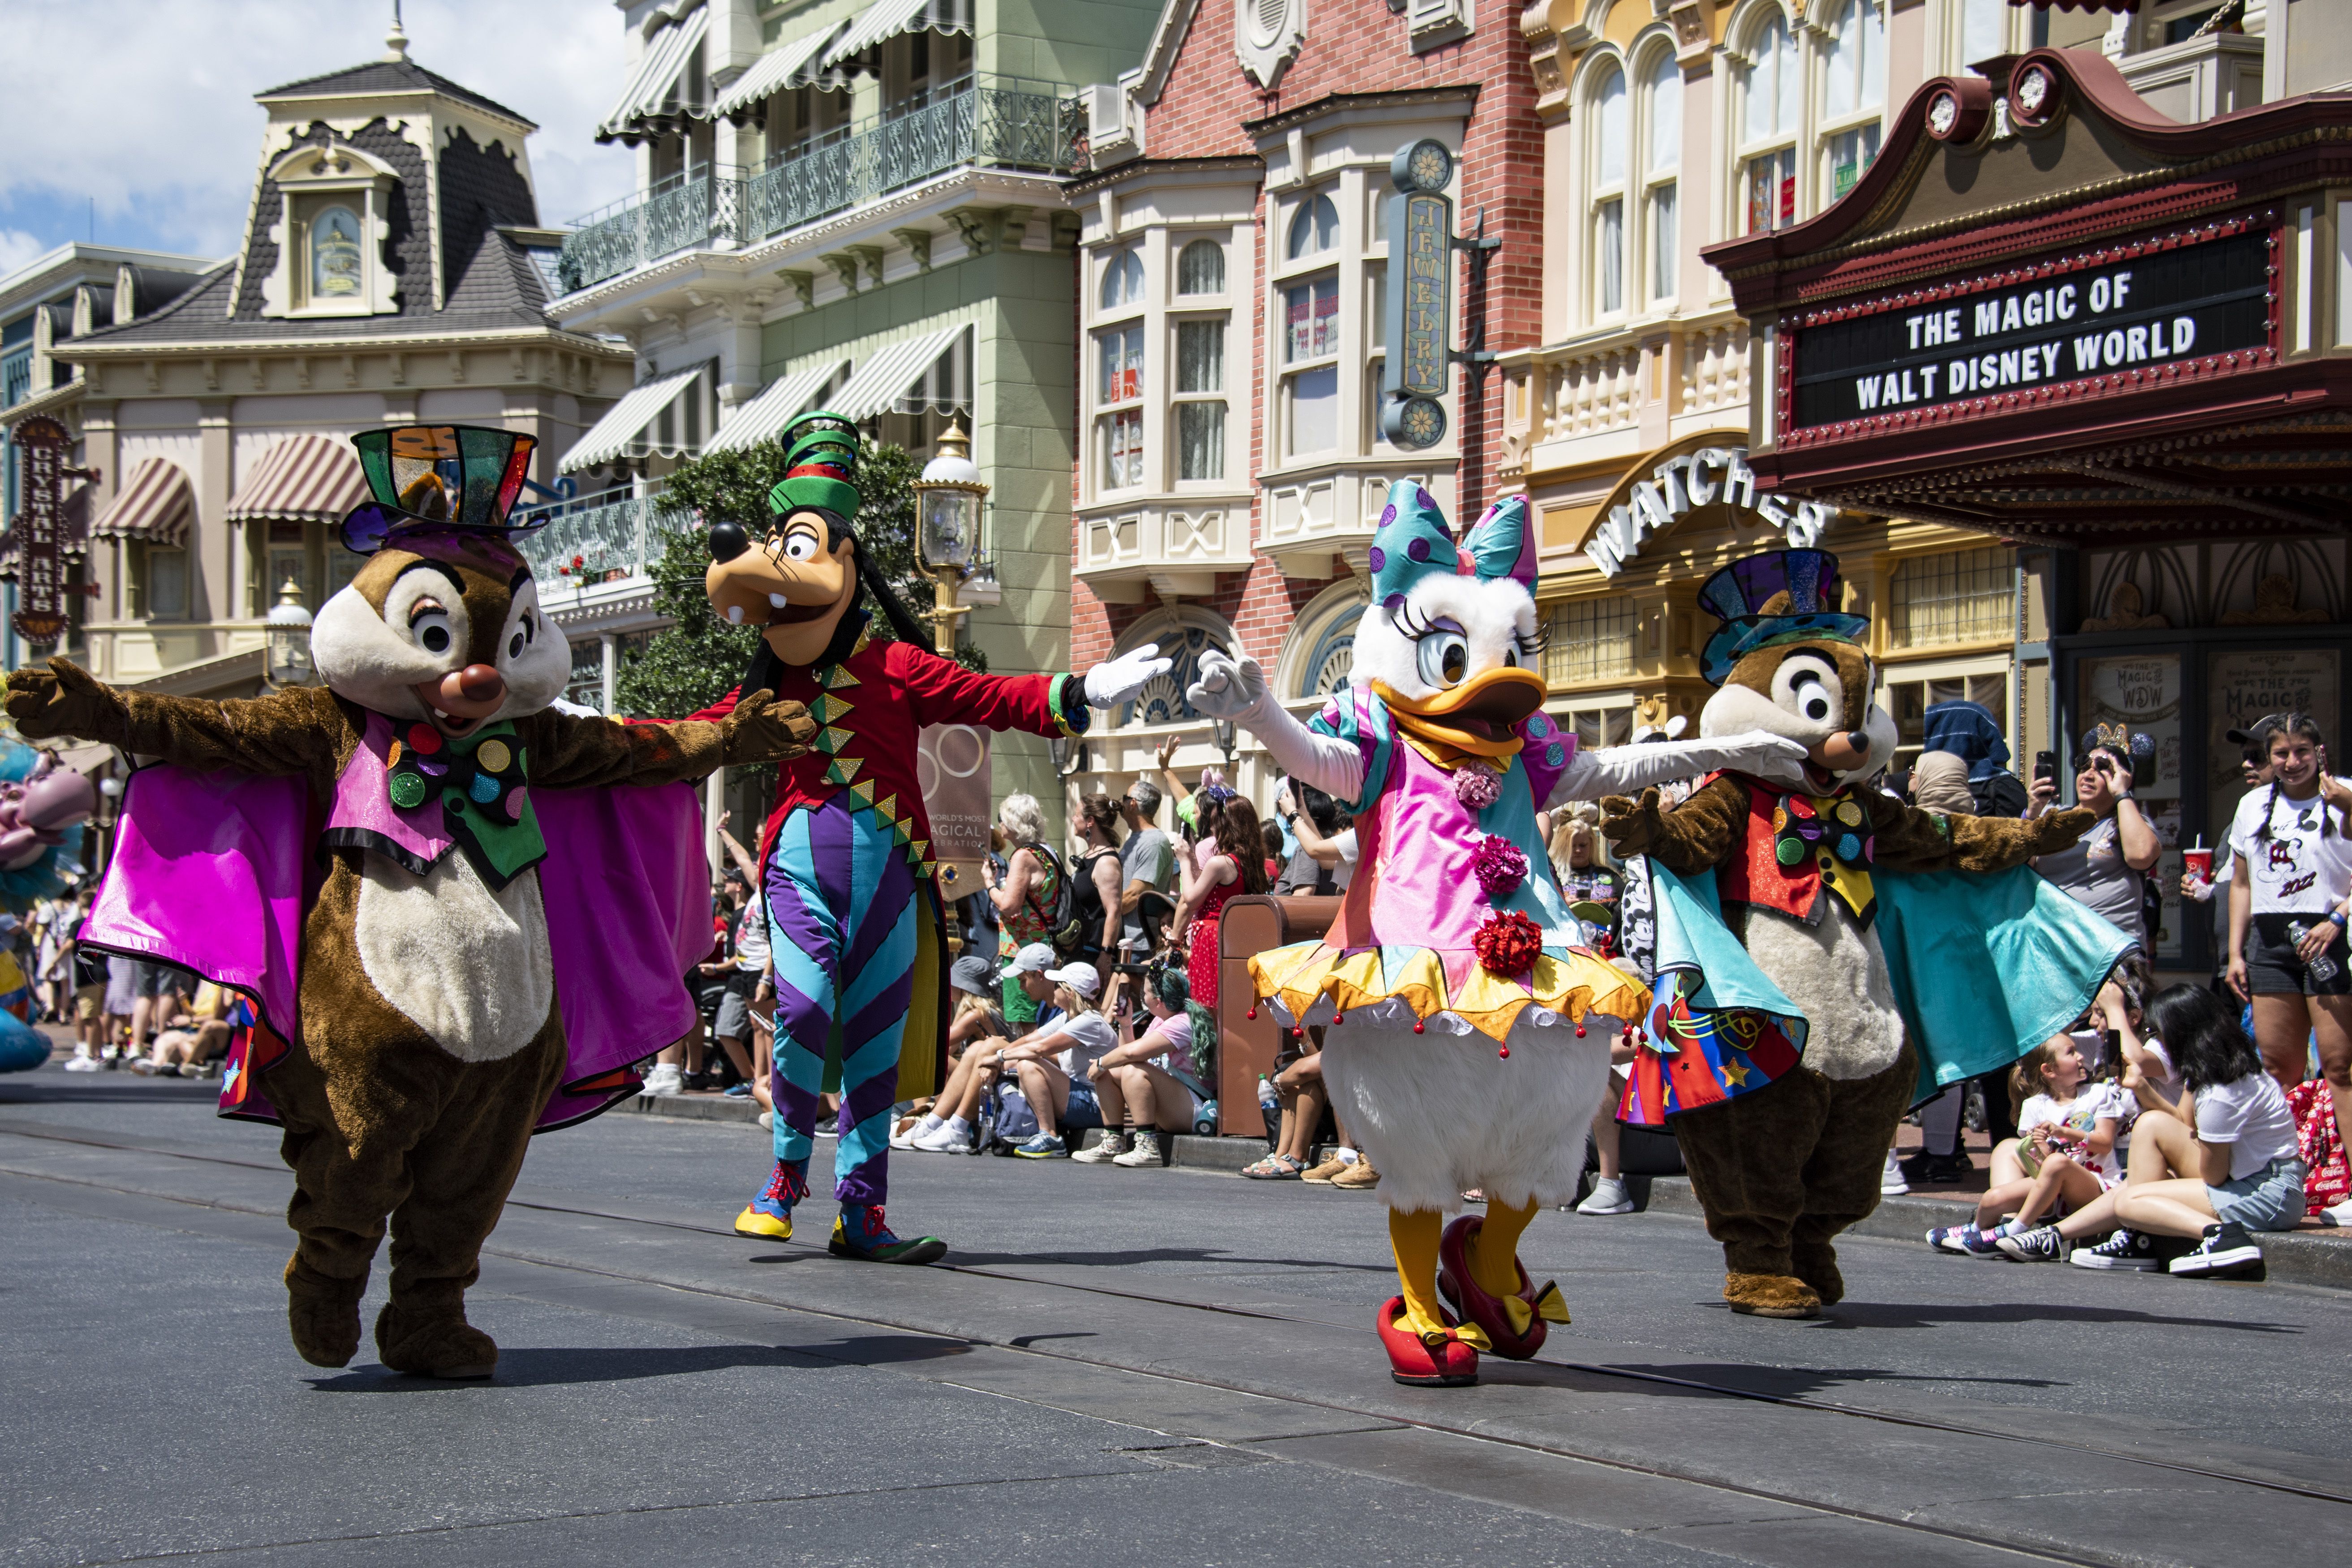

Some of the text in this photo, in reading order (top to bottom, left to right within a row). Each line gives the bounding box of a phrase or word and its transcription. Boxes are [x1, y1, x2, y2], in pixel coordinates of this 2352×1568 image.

[1413, 206, 1437, 385] JEWELRY
[1907, 274, 2130, 349] THE MAGIC OF
[1857, 318, 2194, 409] WALT DISNEY WORLD
[31, 445, 54, 543] CRYSTAL
[1583, 448, 1836, 578] WATCHES
[31, 556, 53, 612] ARTS
[2116, 669, 2152, 687] MAGIC
[2259, 679, 2284, 689] THE
[2120, 685, 2162, 708] WDW
[2222, 686, 2291, 714] MAGIC
[2103, 708, 2117, 718] STEP
[2132, 713, 2158, 722] TIMELESS
[2158, 705, 2176, 717] LANDS
[930, 824, 981, 837] AGICAL
[2278, 871, 2317, 898] 2022
